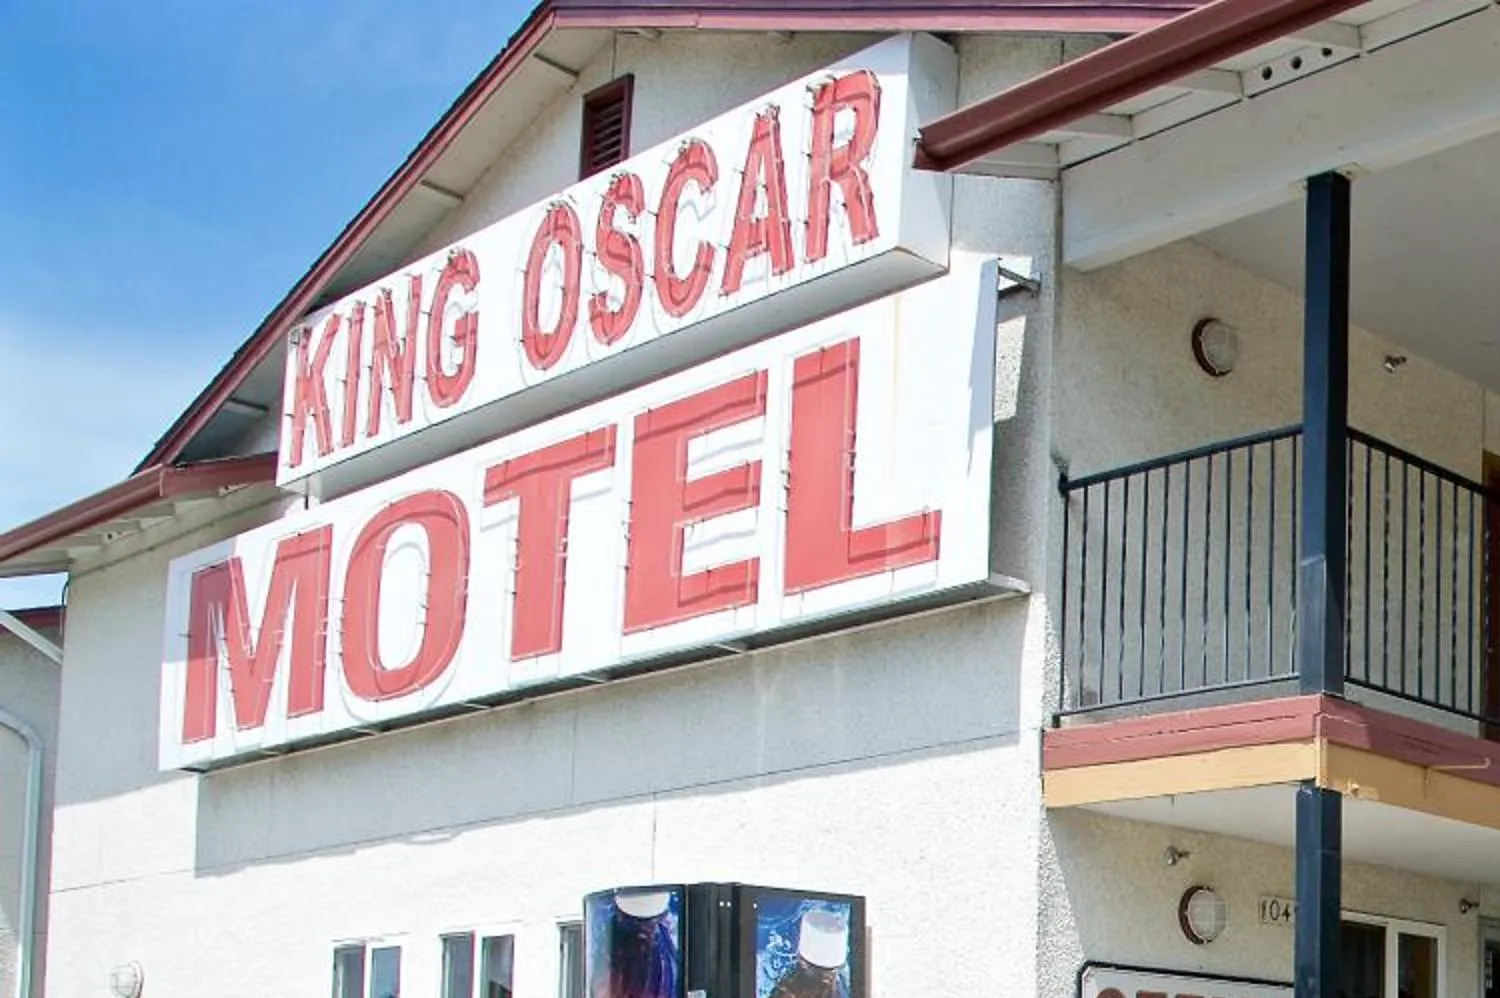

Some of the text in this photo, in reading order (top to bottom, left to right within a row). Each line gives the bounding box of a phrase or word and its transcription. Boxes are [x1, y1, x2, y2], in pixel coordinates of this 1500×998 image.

[289, 67, 883, 468] KING OSCAR
[182, 336, 943, 745] MOTEL
[1261, 899, 1297, 922] 104
